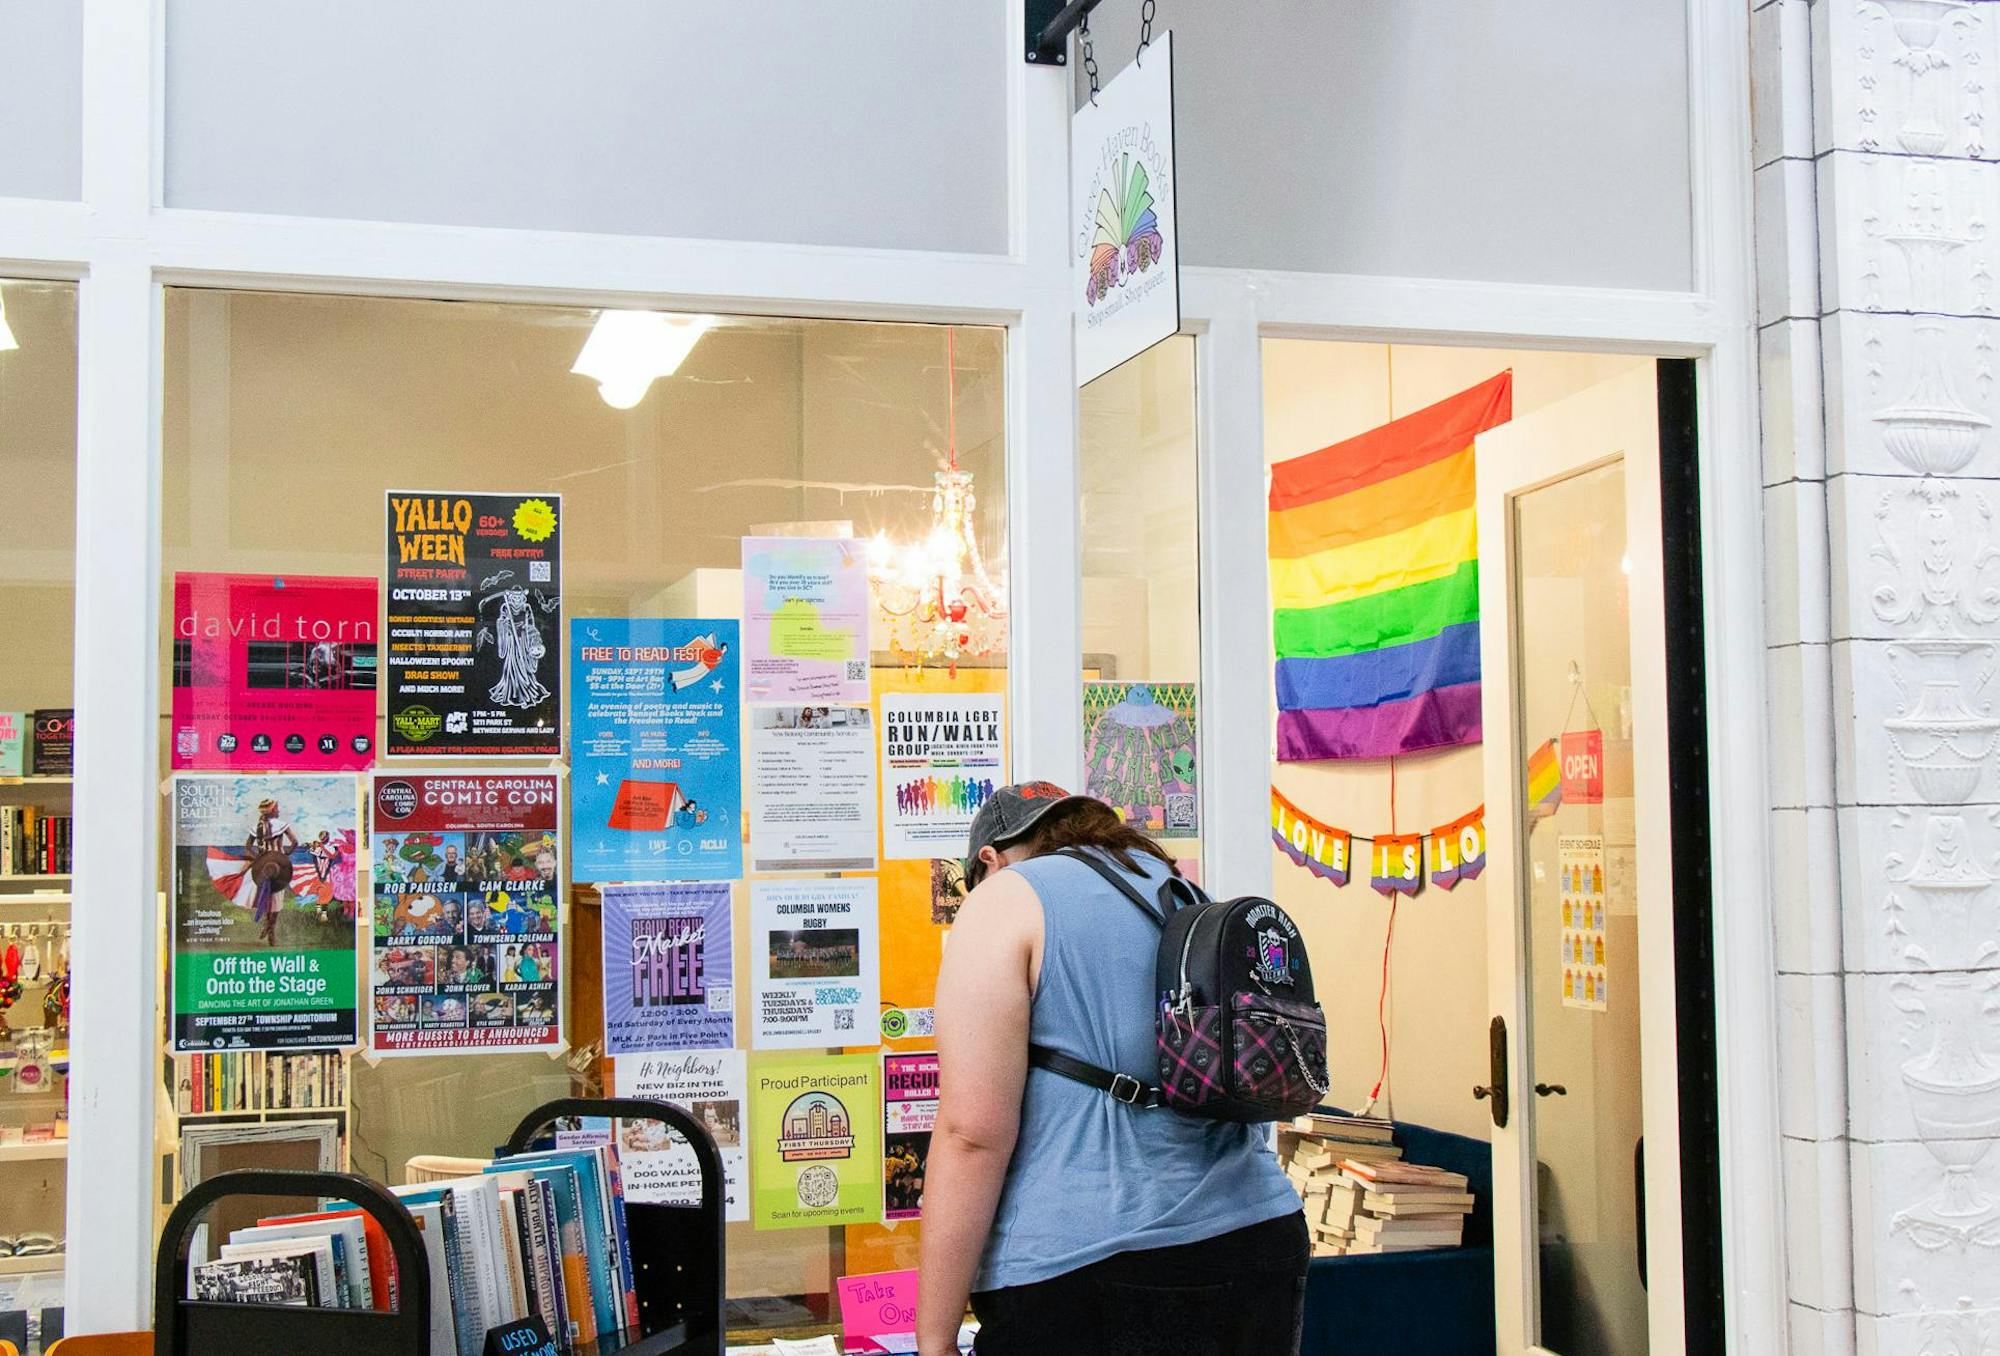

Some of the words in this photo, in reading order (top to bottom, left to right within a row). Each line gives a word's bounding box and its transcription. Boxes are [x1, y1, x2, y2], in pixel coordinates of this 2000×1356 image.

[1101, 125, 1137, 171] Haven
[1140, 121, 1168, 204] Books
[391, 498, 472, 535] YALLO
[479, 516, 505, 528] 60+
[398, 535, 466, 568] WEEN
[491, 549, 513, 559] FREE
[397, 568, 434, 580] STREET
[436, 568, 466, 580] PARTY
[392, 588, 448, 601] OCTOBER
[180, 611, 281, 638] david
[296, 615, 371, 640] torn
[391, 629, 423, 638] OCCULT!
[455, 629, 473, 638] ART!
[392, 643, 425, 652] INSECTS!
[582, 646, 613, 661] FREE
[635, 646, 669, 661] READ
[673, 646, 703, 661] FEST
[441, 657, 475, 666] SPOOKY!
[404, 670, 429, 680] DRAG
[430, 670, 460, 680] SHOW!
[399, 685, 416, 693] AND
[417, 685, 439, 693] MUCH
[440, 685, 465, 694] MORE!
[446, 711, 468, 723] ART
[888, 710, 959, 723] COLUMBIA
[965, 710, 998, 723] LGBT
[446, 722, 468, 734] BAR
[888, 724, 998, 742] RUN/WALK
[888, 743, 930, 756] GROUP
[632, 759, 653, 769] AND
[653, 759, 682, 768] MORE!
[1565, 754, 1598, 781] OPEN
[180, 784, 225, 797] SOUTH
[424, 780, 483, 791] CENTRAL
[486, 779, 554, 790] CAROLINA
[180, 796, 243, 808] CAROLIN
[424, 791, 499, 805] COMIC
[508, 791, 553, 805] CON
[1276, 806, 1344, 872] LOVE
[1381, 845, 1417, 881] IS
[1439, 825, 1480, 873] LO
[1560, 839, 1574, 850] EVENT
[1575, 839, 1601, 850] SCHEDULE
[384, 882, 407, 894] ROB
[409, 882, 458, 893] PAULSEN
[479, 880, 503, 892] CAM
[505, 880, 547, 891] CLARKE
[777, 903, 815, 915] COLUMBIA
[816, 902, 851, 913] WOMENS
[803, 918, 827, 929] RUGBY
[1245, 903, 1277, 930] MONSTER
[1278, 912, 1298, 940] HIGH
[387, 936, 417, 946] BARRY
[418, 935, 454, 945] GORDON
[473, 934, 516, 944] TOWNSEND
[517, 933, 555, 943] COLEMAN
[629, 924, 705, 966] Market
[213, 956, 239, 976] Off
[239, 957, 267, 974] the
[270, 955, 306, 974] Wall
[308, 958, 320, 973] &
[632, 939, 705, 1003] FREE
[206, 979, 250, 995] Onto
[249, 977, 275, 994] the
[279, 976, 326, 996] Stage
[376, 986, 396, 995] JOHN
[396, 985, 434, 994] SCHNEIDER
[444, 984, 464, 992] JOHN
[465, 984, 491, 992] GLOVER
[504, 983, 528, 991] KARAN
[528, 982, 554, 991] ASHLEY
[761, 991, 797, 999] WEEKLY
[198, 1000, 231, 1009] DANCING
[232, 999, 247, 1008] THE
[247, 999, 262, 1008] ART
[262, 999, 272, 1007] OF
[273, 998, 310, 1007] JONATHAN
[310, 997, 334, 1006] GREEN
[762, 999, 807, 1008] TUESDAYS
[641, 1009, 668, 1018] 12:00
[676, 1008, 699, 1017] 3:00
[762, 1006, 814, 1016] THURSDAYS
[195, 1016, 238, 1026] SEPTEMBER
[255, 1014, 293, 1024] TOWNSHIP
[293, 1012, 338, 1023] AUDITORIUM
[608, 1021, 623, 1029] 3rd
[625, 1019, 664, 1029] Saturday
[666, 1018, 675, 1026] of
[678, 1017, 703, 1028] Every
[704, 1016, 732, 1025] Month
[762, 1014, 809, 1024] 7:00-9:00PM
[386, 1031, 417, 1043] MORE
[418, 1030, 455, 1041] GUESTS
[456, 1029, 471, 1040] TO
[473, 1028, 487, 1040] BE
[488, 1027, 550, 1039] ANNOUNCED
[612, 1036, 632, 1044] MLK
[634, 1034, 646, 1042] Jr.
[648, 1033, 667, 1042] Park
[670, 1032, 678, 1040] in
[679, 1032, 699, 1041] Five
[700, 1030, 729, 1039] Points
[621, 1041, 645, 1049] Corner
[646, 1040, 655, 1048] of
[639, 1061, 654, 1079] Hi
[656, 1055, 723, 1081] Neighbors!
[901, 1064, 916, 1073] THE
[687, 1081, 700, 1089] IN
[760, 1076, 799, 1090] Proud
[800, 1073, 868, 1089] Participant
[888, 1072, 940, 1090] REGUL
[632, 1090, 729, 1100] NEIGHBORHOOD!
[581, 1132, 609, 1141] Affirming
[784, 1141, 806, 1149] FIRST
[809, 1139, 850, 1148] THURSDAY
[634, 1170, 658, 1178] DOG
[527, 1178, 537, 1203] BILLY
[627, 1181, 680, 1190] IN-HOME
[680, 1180, 701, 1188] PET
[771, 1211, 791, 1220] Scan
[792, 1210, 802, 1218] for
[803, 1209, 839, 1219] upcoming
[839, 1207, 865, 1215] events
[530, 1203, 545, 1247] PORTER
[501, 1328, 538, 1351] USED
